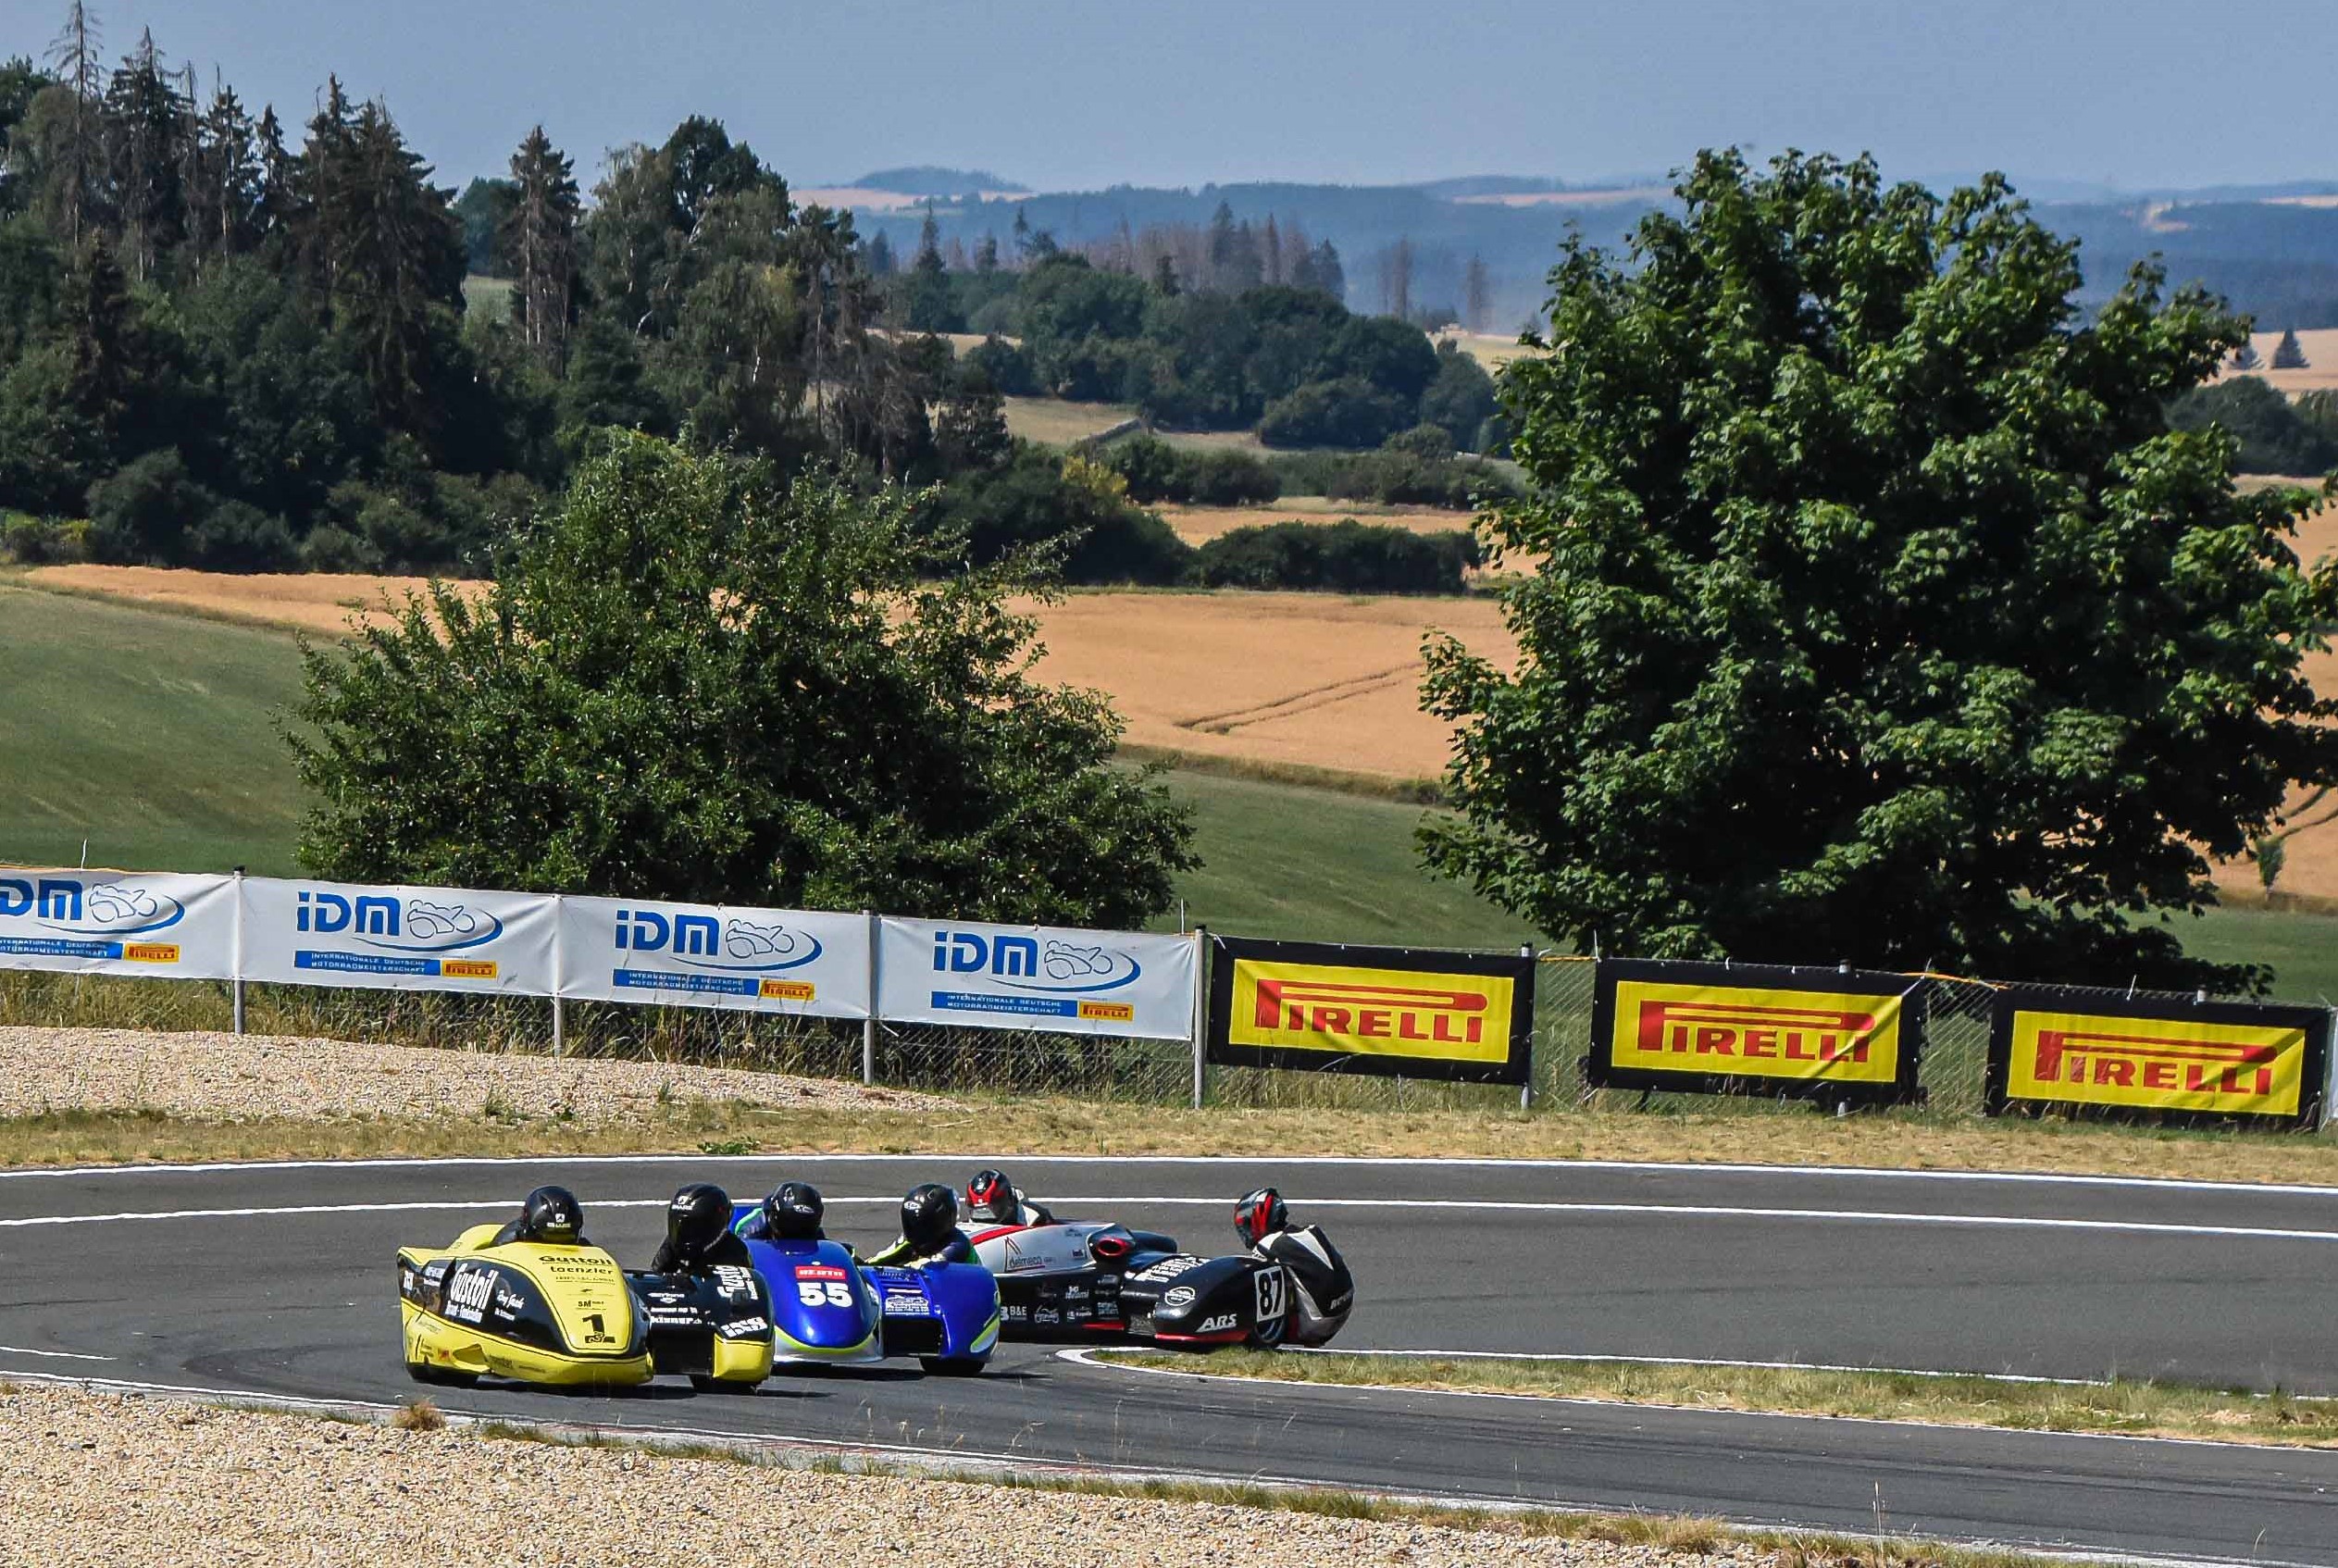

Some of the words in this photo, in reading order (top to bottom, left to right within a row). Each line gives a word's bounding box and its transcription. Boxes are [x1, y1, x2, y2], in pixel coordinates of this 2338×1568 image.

[0, 879, 83, 921] DM
[0, 938, 61, 948] NTERNATIONALE
[1083, 1003, 1129, 1018] PIRELLI
[1253, 978, 1488, 1043] PIRELLI
[1637, 1000, 1876, 1063] PIRELLI
[2034, 1029, 2278, 1096] PIRELLI
[797, 1282, 853, 1308] 55
[1258, 1270, 1283, 1317] 87
[582, 1314, 616, 1344] 1
[1195, 1313, 1237, 1334] ARS
